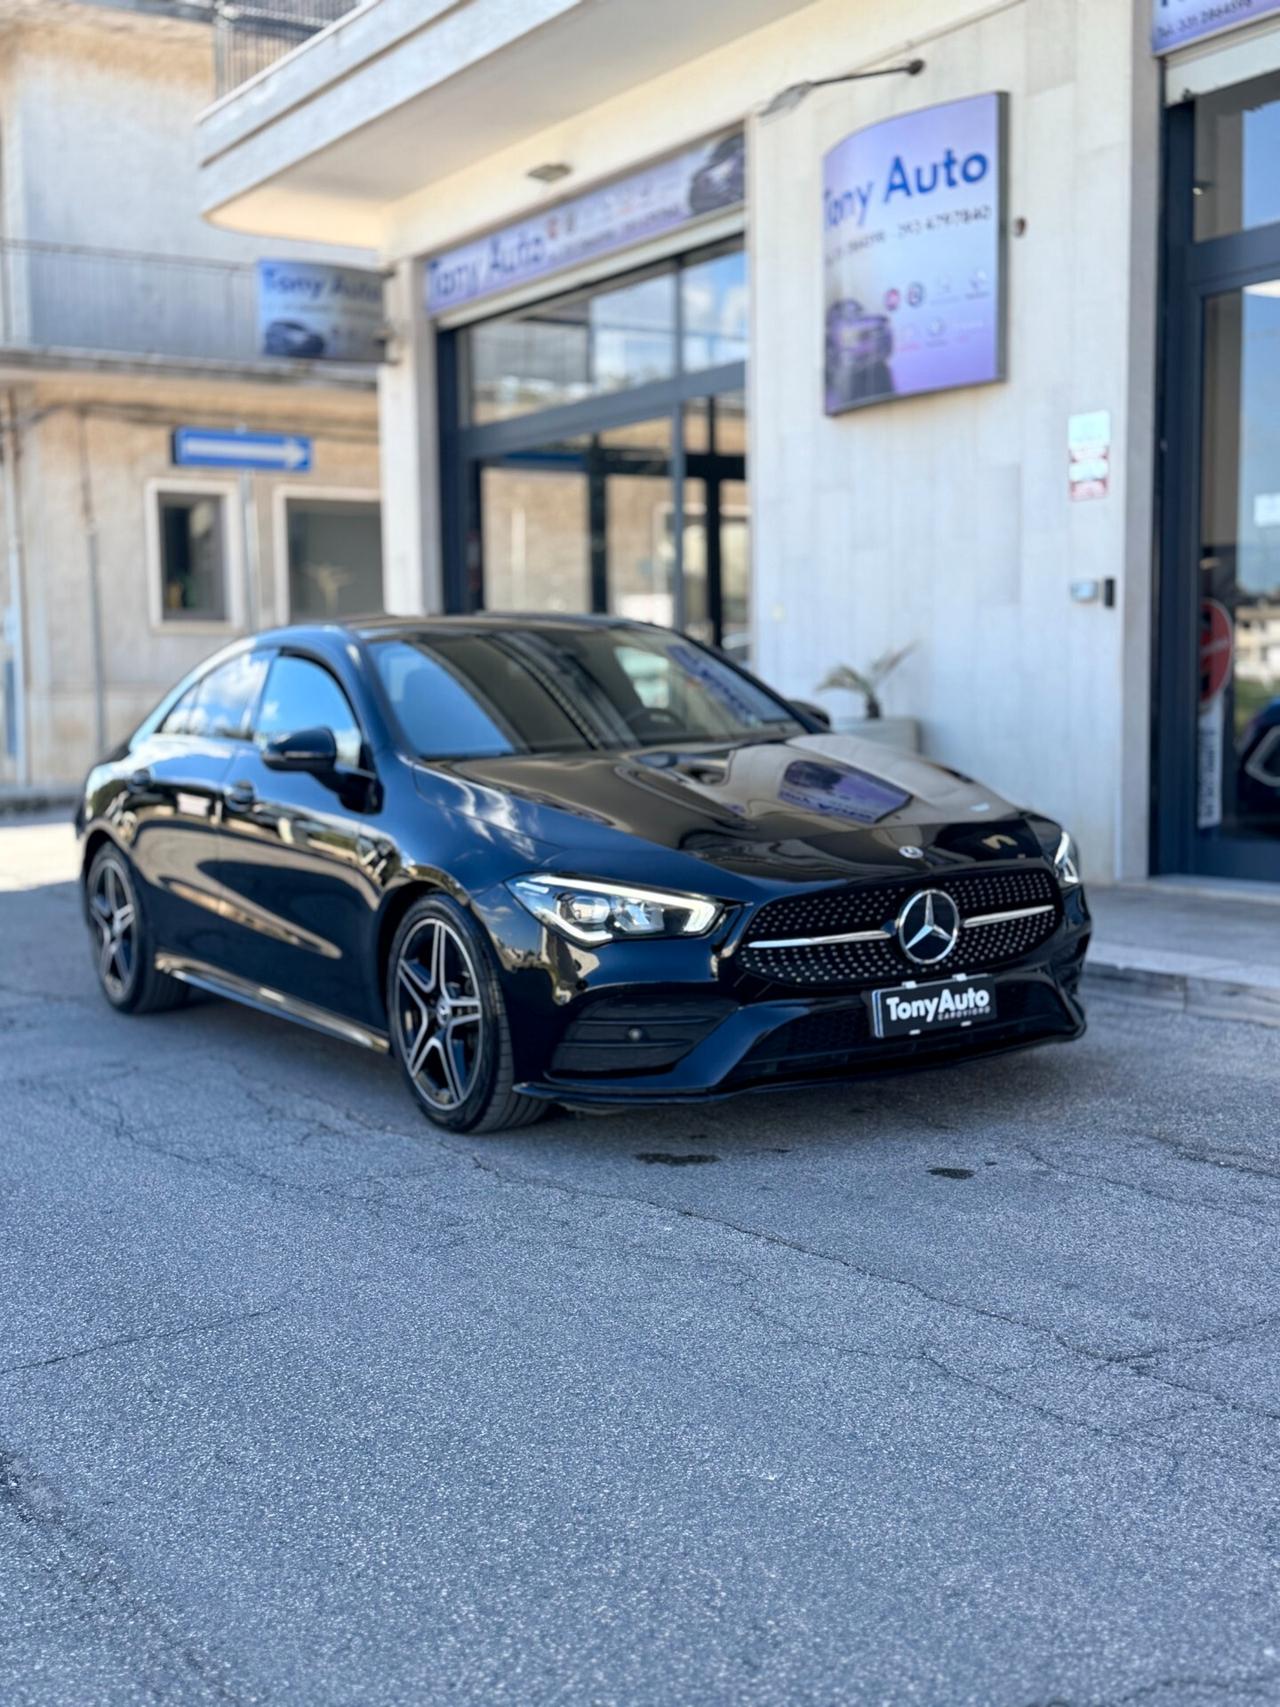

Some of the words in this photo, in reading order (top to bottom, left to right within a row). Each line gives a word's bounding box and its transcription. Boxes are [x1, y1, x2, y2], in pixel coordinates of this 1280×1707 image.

[824, 181, 873, 228] Tony
[883, 148, 989, 203] Auto
[264, 268, 323, 298] Tony
[333, 275, 380, 301] Auto
[427, 258, 484, 297] Tony
[489, 233, 547, 275] Auto
[886, 988, 990, 1022] TonyAuto
